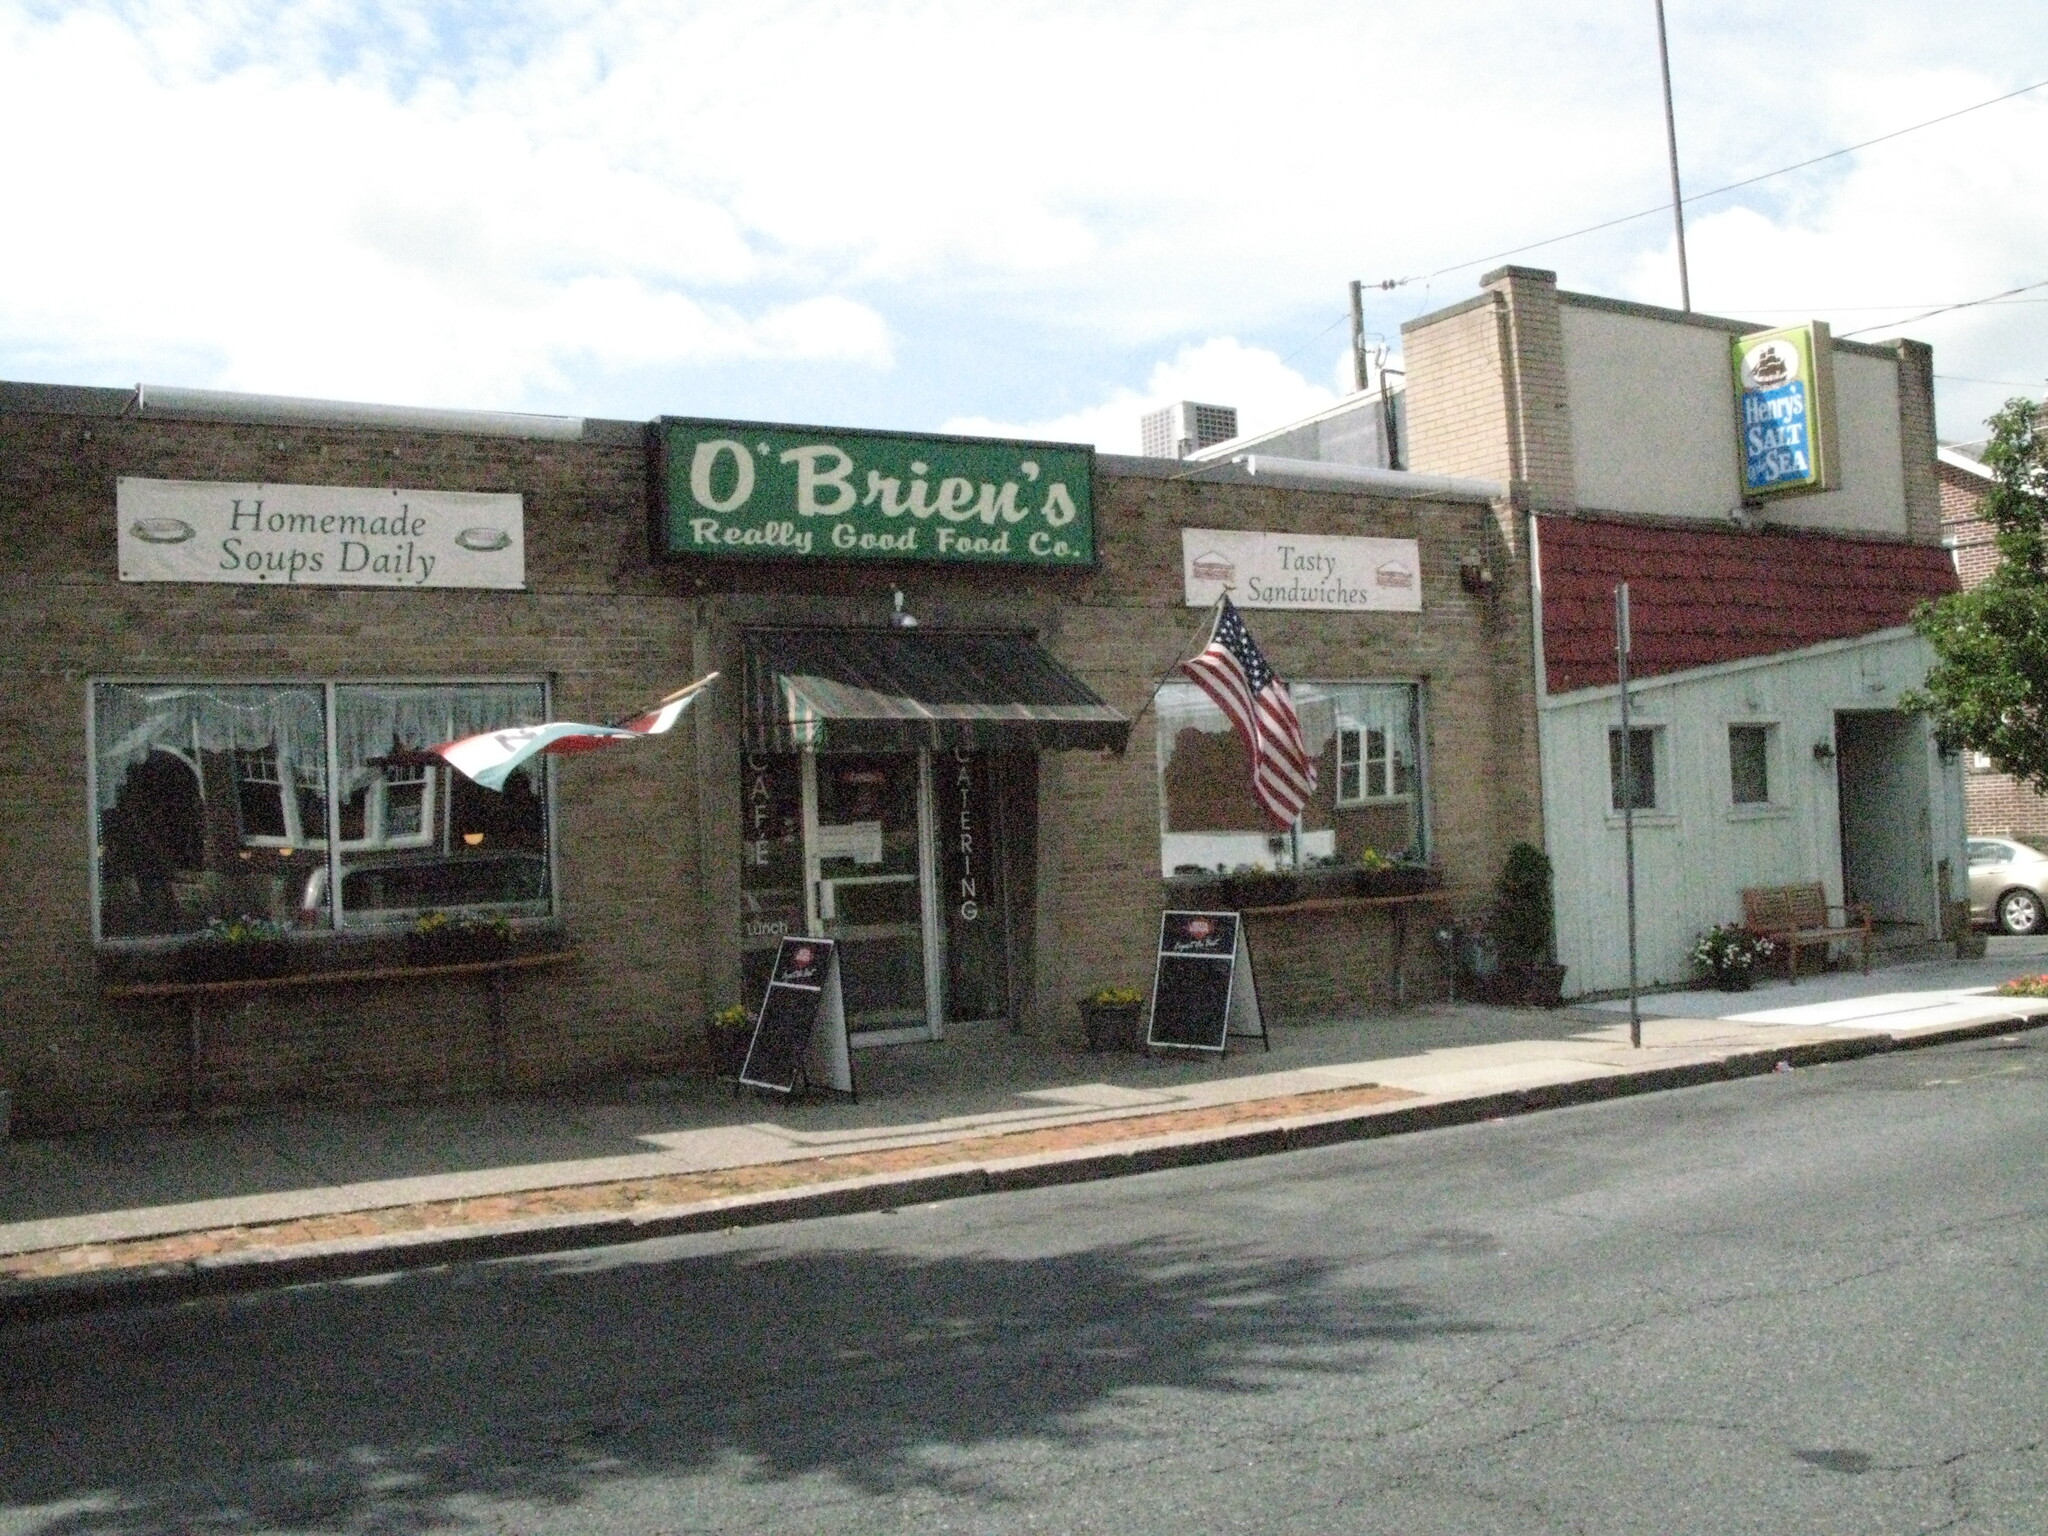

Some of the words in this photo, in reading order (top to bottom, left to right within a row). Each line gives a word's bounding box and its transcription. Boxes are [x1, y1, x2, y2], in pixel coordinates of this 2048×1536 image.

[1745, 386, 1804, 425] Henry's
[690, 440, 1077, 528] O'Brien's
[229, 499, 427, 537] Homemade
[688, 518, 813, 554] Really
[831, 523, 919, 551] Good
[936, 528, 1011, 555] Food
[1028, 532, 1081, 558] Co.
[219, 537, 325, 582] Soups
[338, 541, 437, 584] Daily
[1277, 546, 1337, 580] Tasty
[1247, 577, 1368, 605] Sandwiches
[955, 749, 978, 920] CATERING
